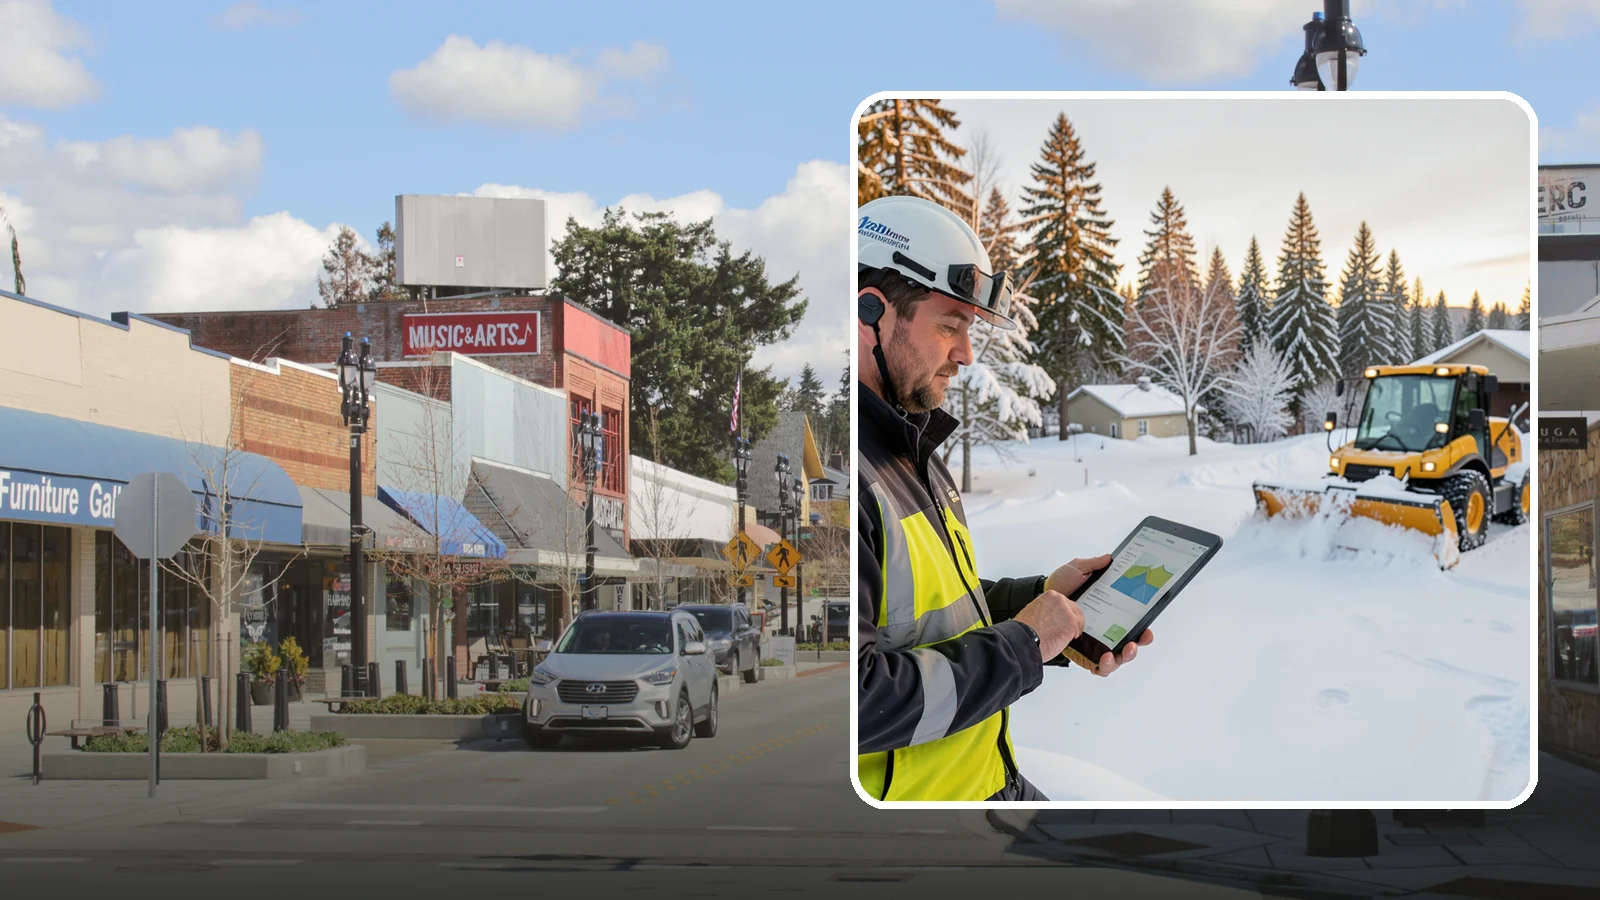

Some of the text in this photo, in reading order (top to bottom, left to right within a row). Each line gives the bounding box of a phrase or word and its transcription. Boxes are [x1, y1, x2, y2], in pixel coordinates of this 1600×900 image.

[409, 322, 520, 349] MUSIC&ARTS
[0, 471, 123, 519] Furniture Gal
